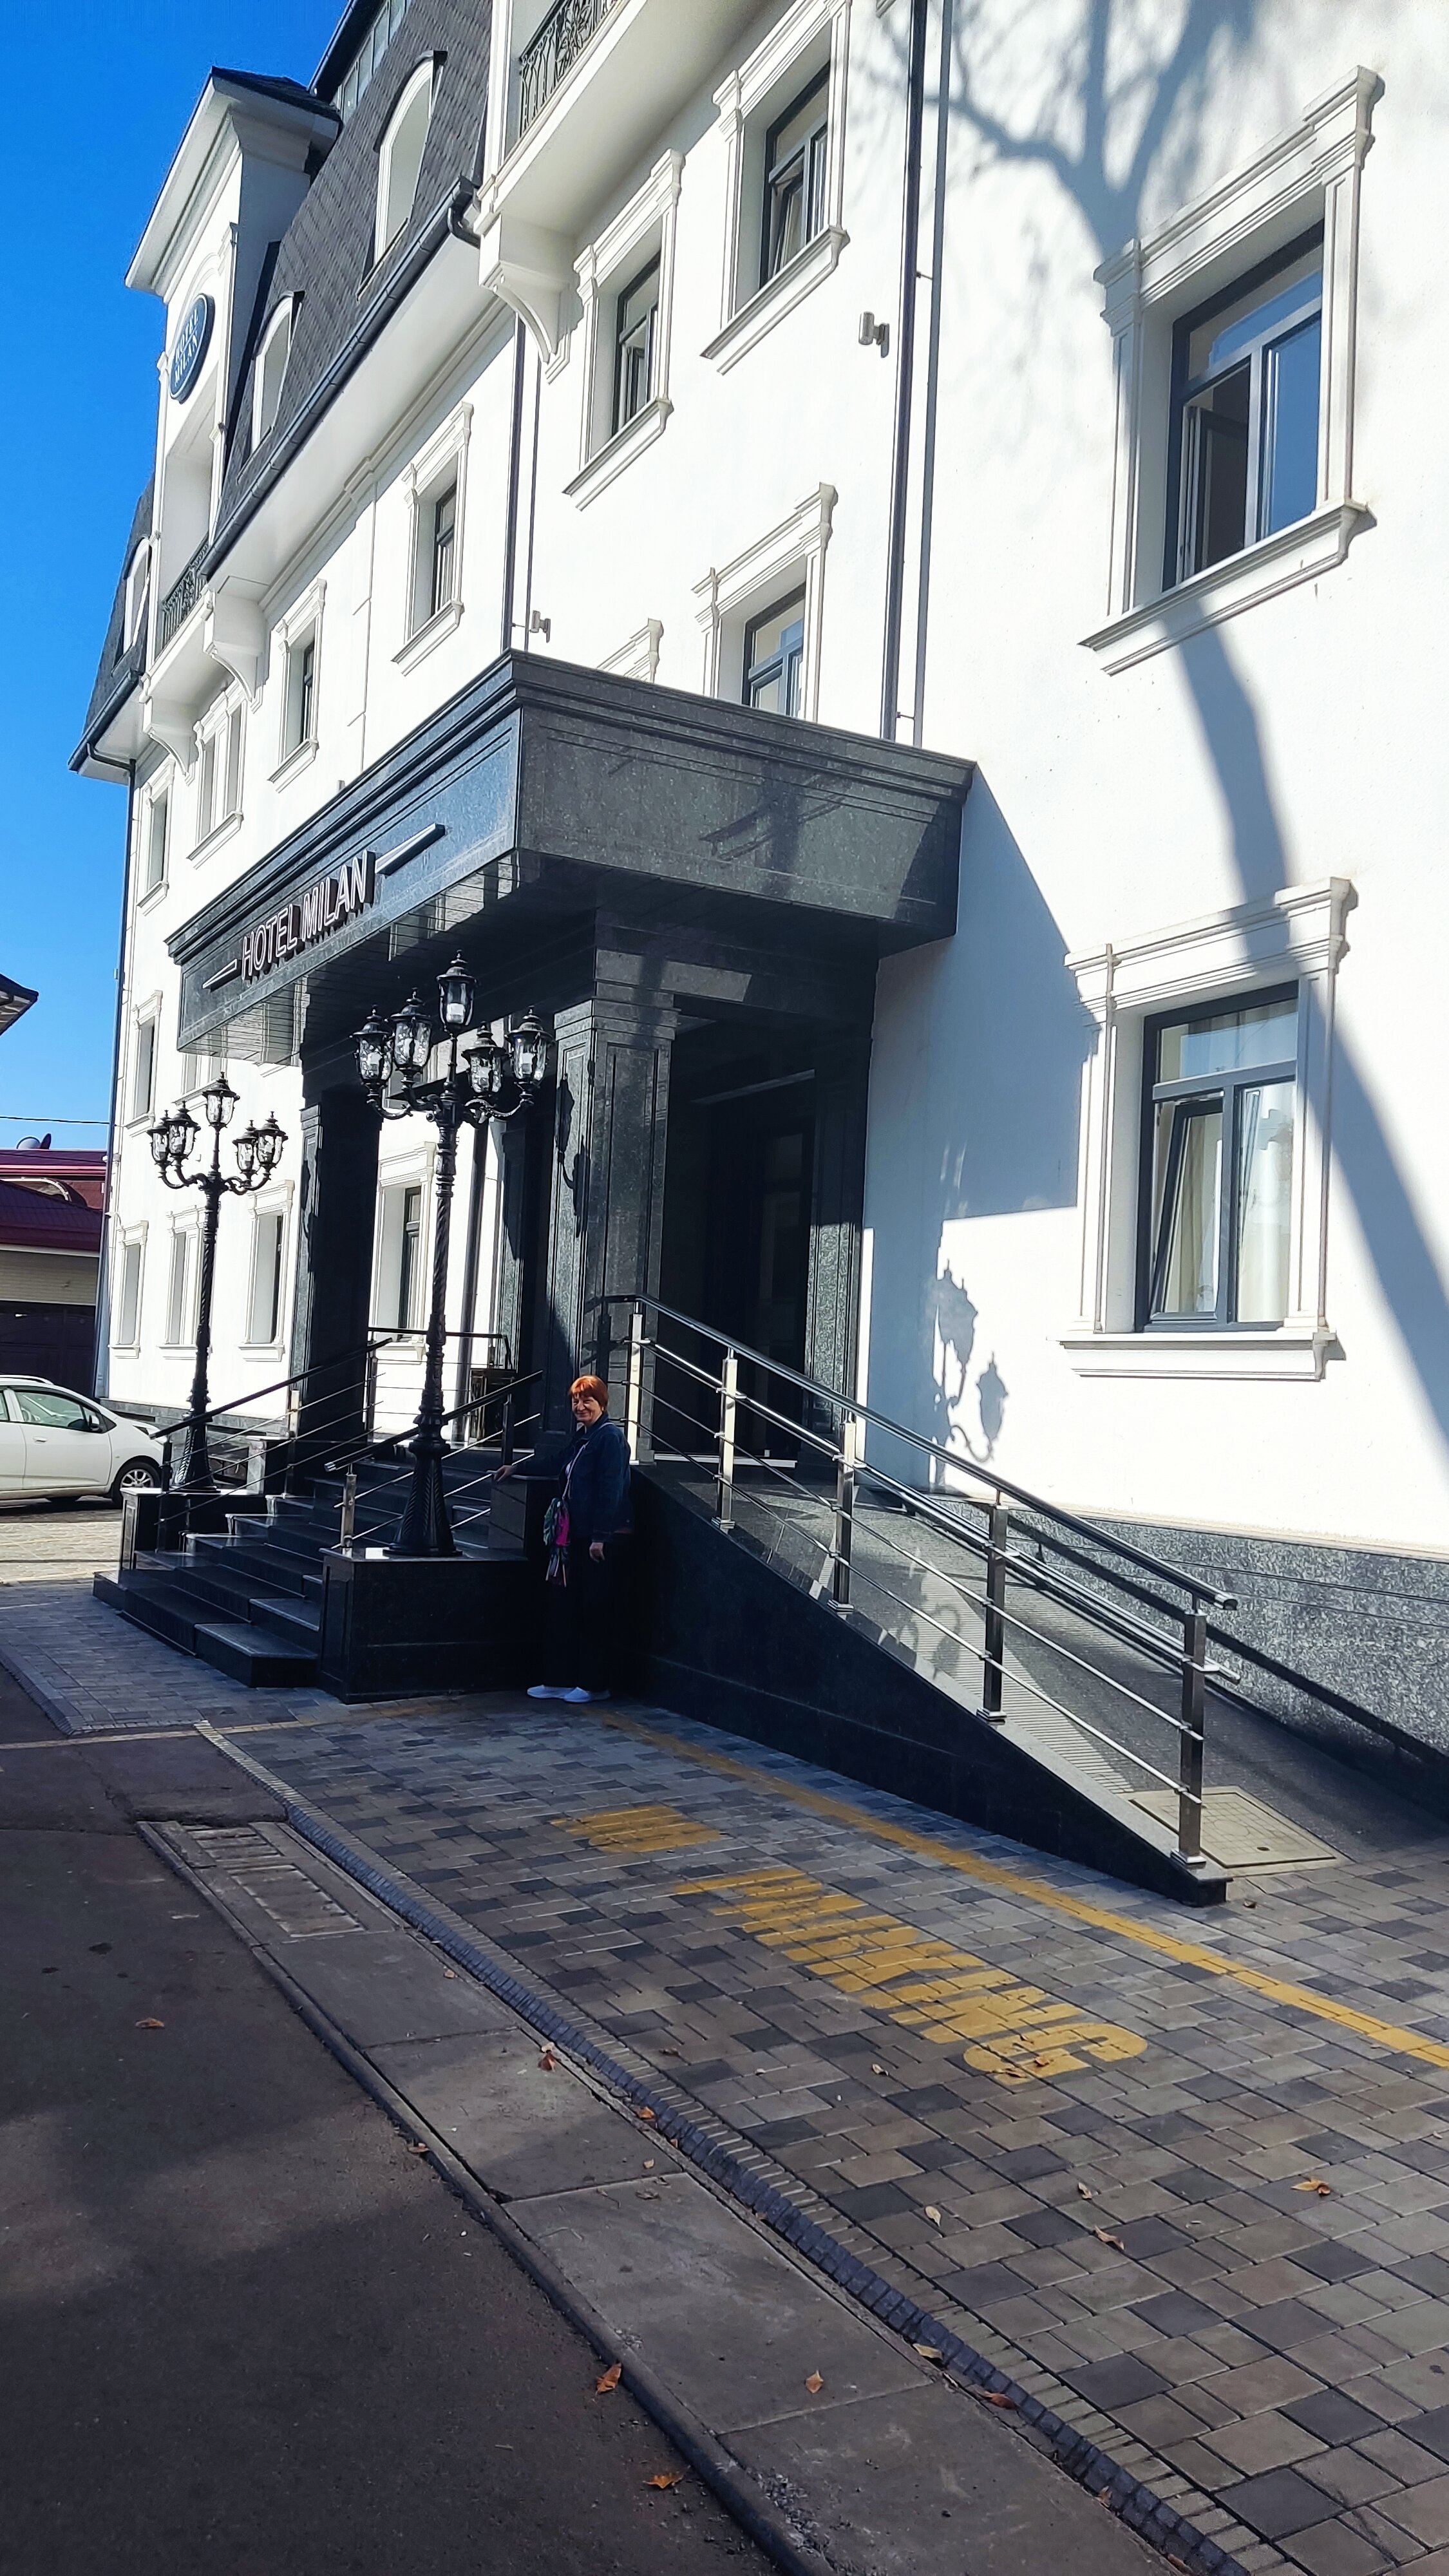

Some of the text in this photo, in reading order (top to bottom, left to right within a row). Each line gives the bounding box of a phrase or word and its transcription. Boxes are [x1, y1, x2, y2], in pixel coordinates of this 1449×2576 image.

[241, 849, 368, 981] HOTEL MILAN
[674, 1865, 1148, 2085] PARKING
